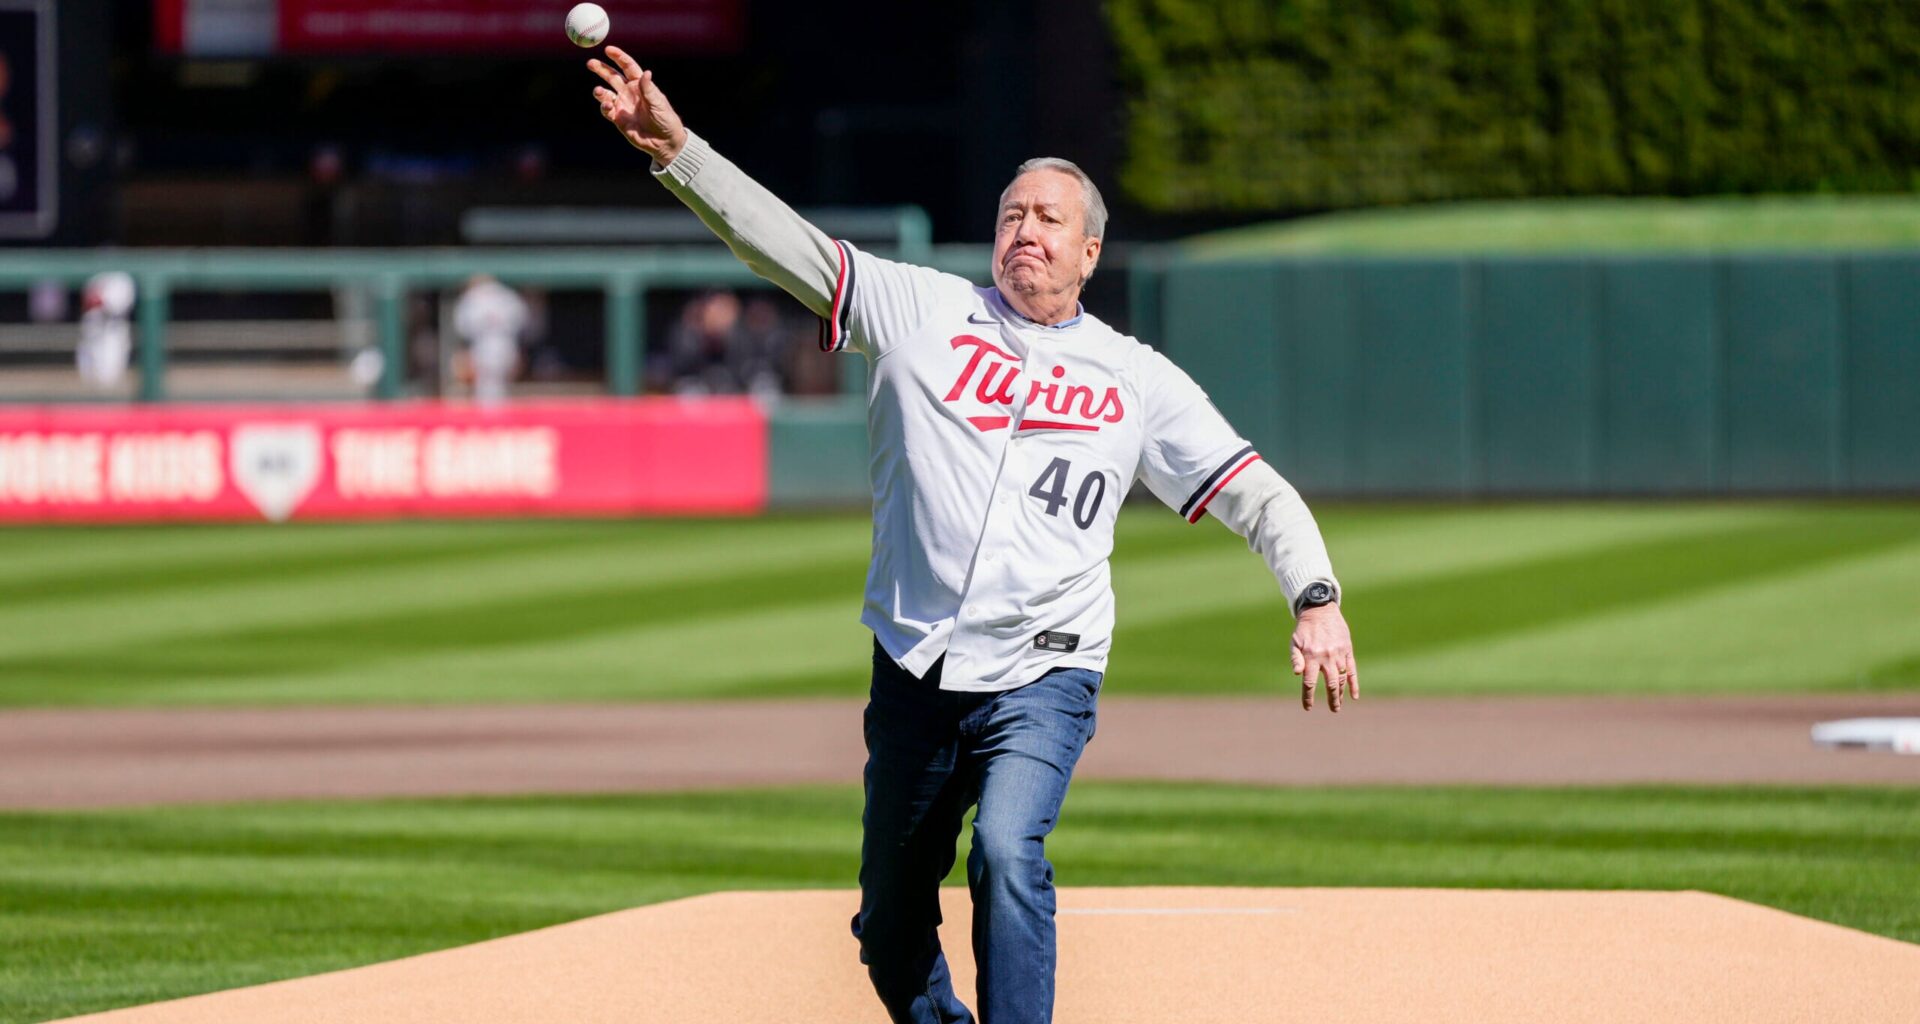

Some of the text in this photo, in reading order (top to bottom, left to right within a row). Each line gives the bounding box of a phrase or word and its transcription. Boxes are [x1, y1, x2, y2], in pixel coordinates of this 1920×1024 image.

[943, 335, 1124, 424] Twins
[107, 431, 223, 502] KIDS
[333, 428, 417, 498] THE
[422, 427, 559, 498] GAME
[1028, 457, 1106, 531] 40
